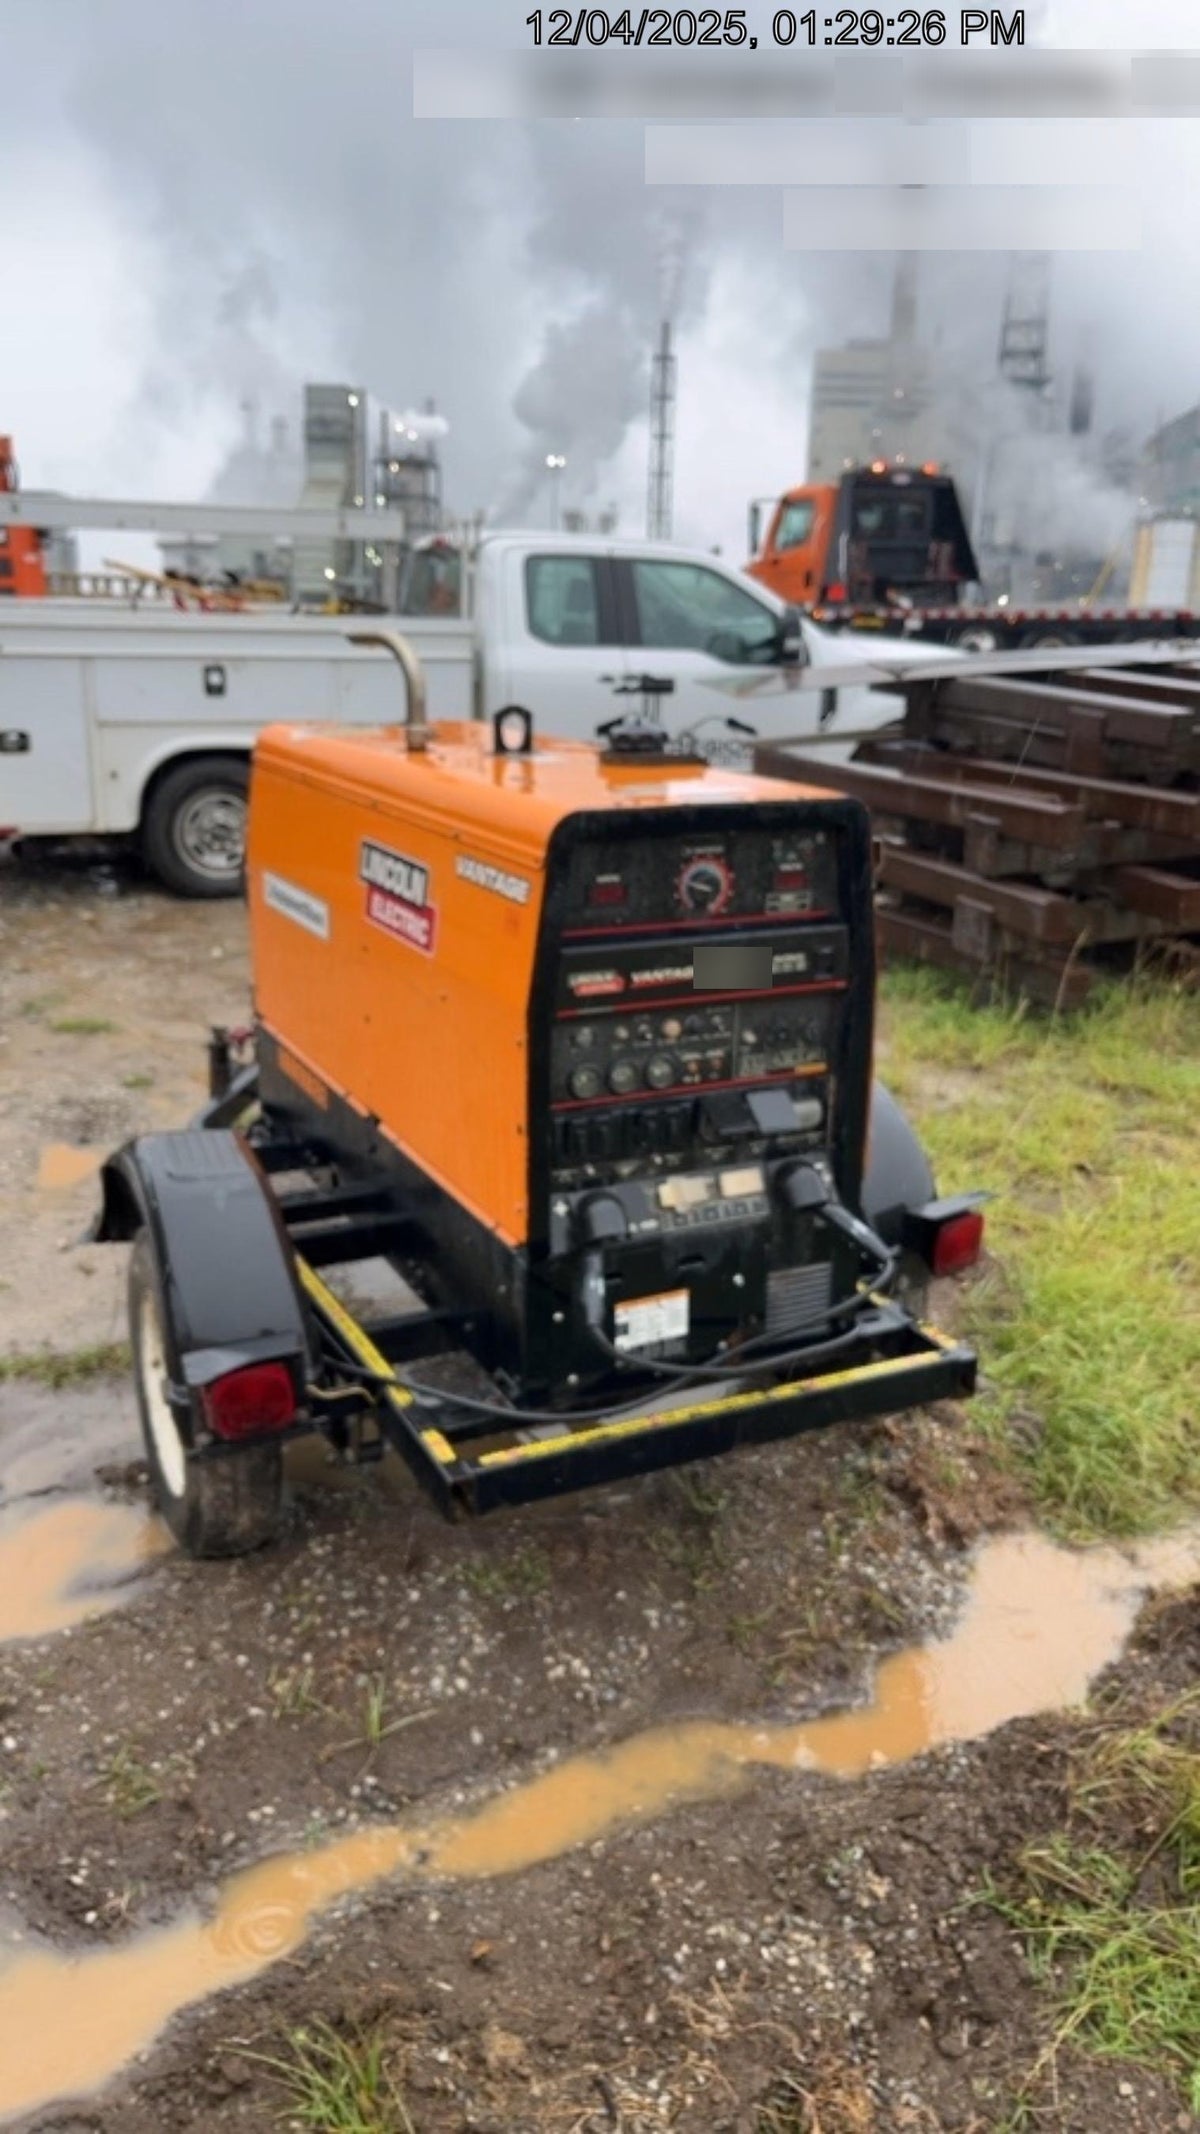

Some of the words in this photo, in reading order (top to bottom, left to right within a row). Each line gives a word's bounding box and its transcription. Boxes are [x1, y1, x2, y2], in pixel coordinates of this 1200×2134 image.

[362, 844, 427, 906] LINCOLN
[455, 854, 530, 904] VANTAGE
[371, 886, 431, 946] ELECTRIC
